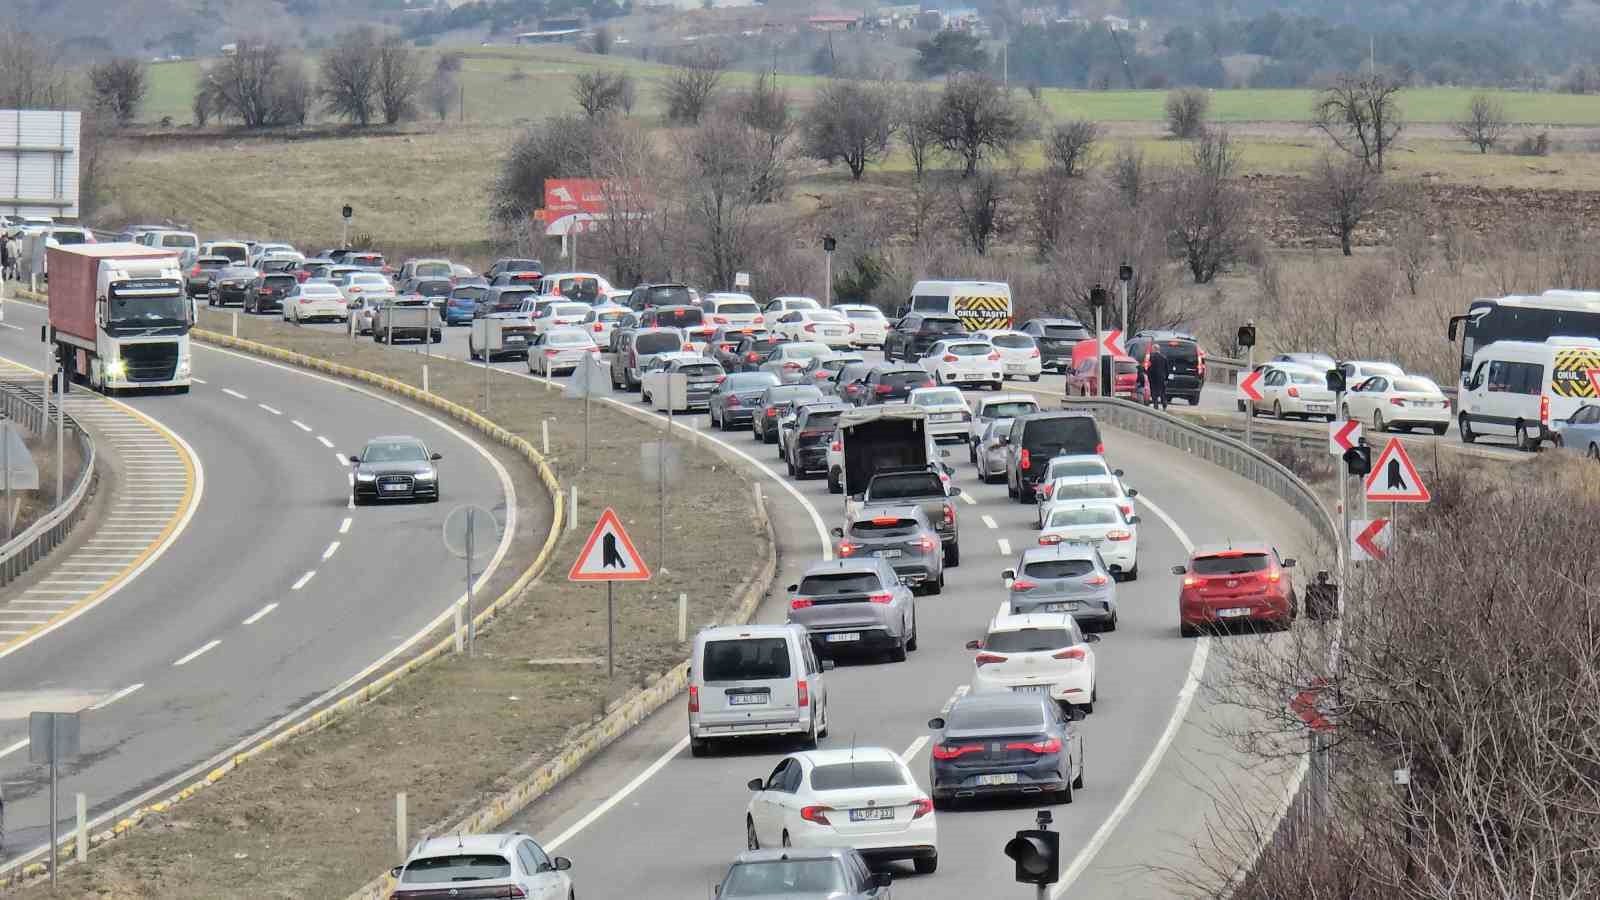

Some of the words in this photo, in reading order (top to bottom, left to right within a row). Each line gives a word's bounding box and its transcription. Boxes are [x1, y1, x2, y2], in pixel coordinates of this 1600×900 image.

[957, 310, 979, 318] OKUL
[981, 310, 1007, 318] TAŞITI
[1557, 371, 1580, 380] OKUL
